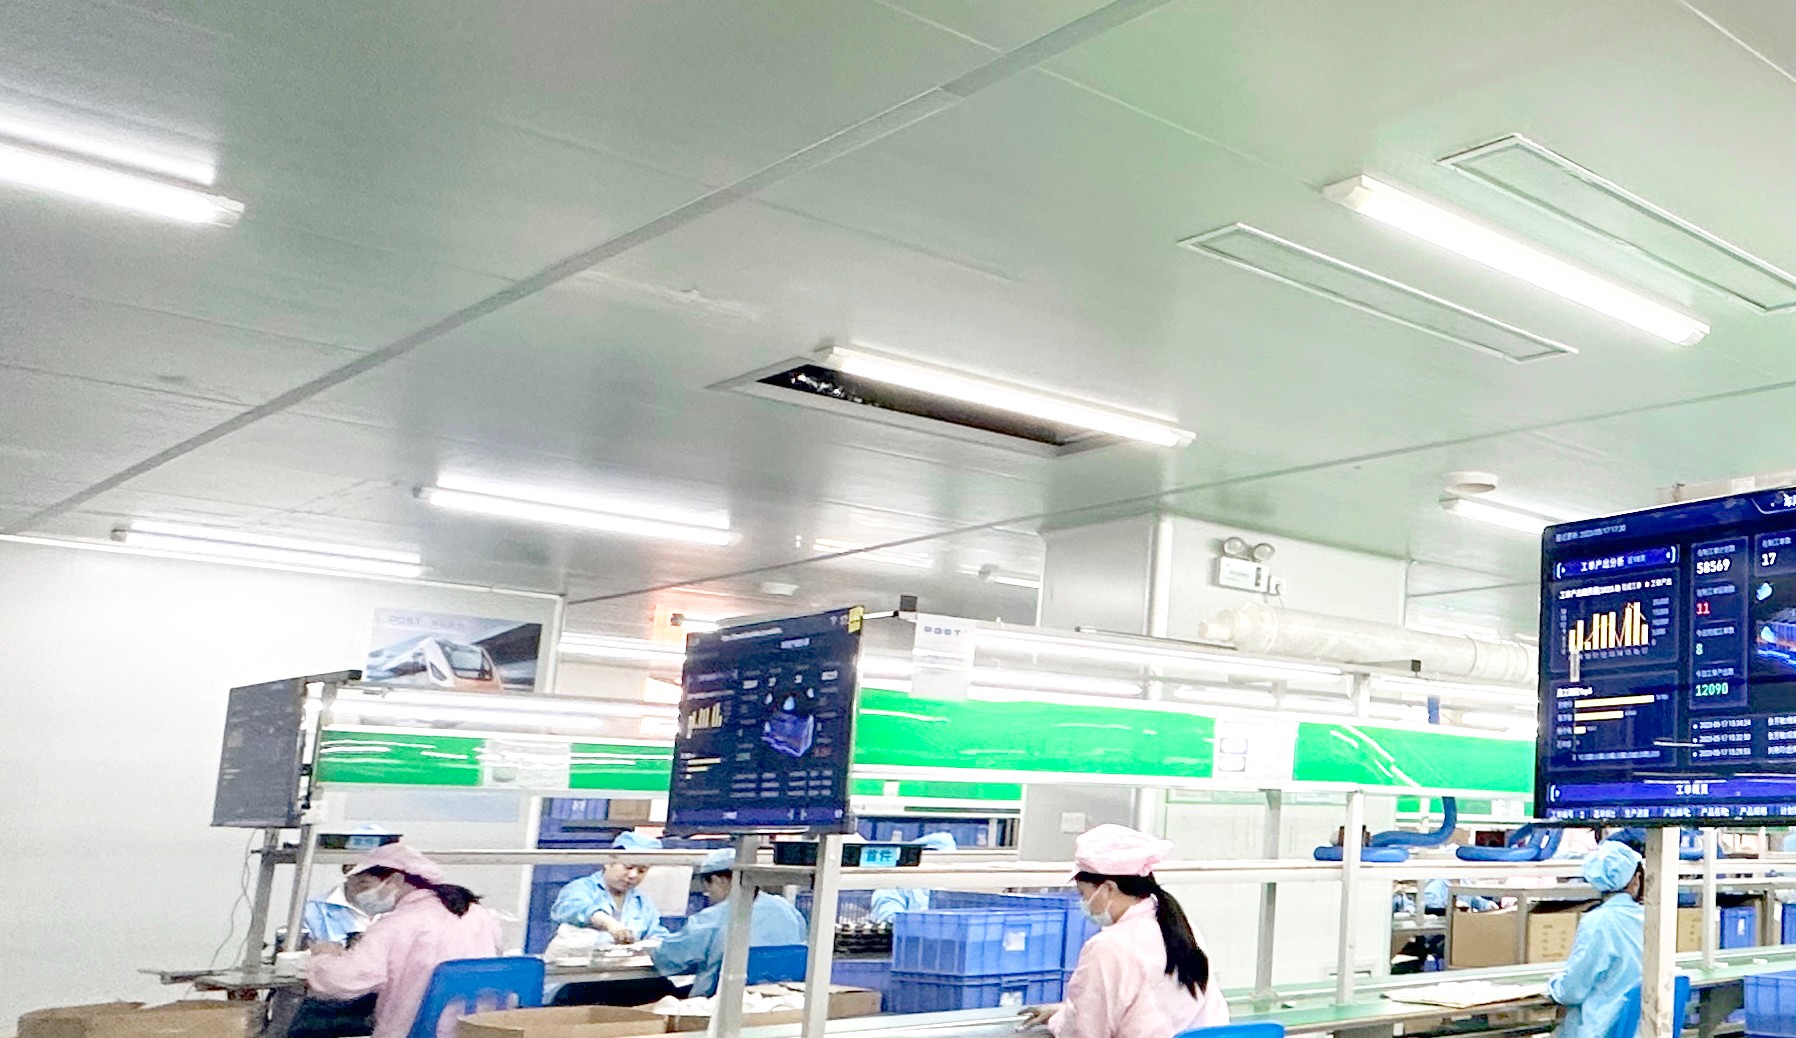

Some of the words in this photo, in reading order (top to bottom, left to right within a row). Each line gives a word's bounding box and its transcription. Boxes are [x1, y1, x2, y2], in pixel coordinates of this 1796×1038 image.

[1761, 552, 1776, 566] 17
[1696, 558, 1731, 575] 58569
[1696, 602, 1711, 615] 11
[1695, 643, 1704, 655] 8
[1695, 682, 1729, 697] 12090
[866, 848, 893, 862] 首件
